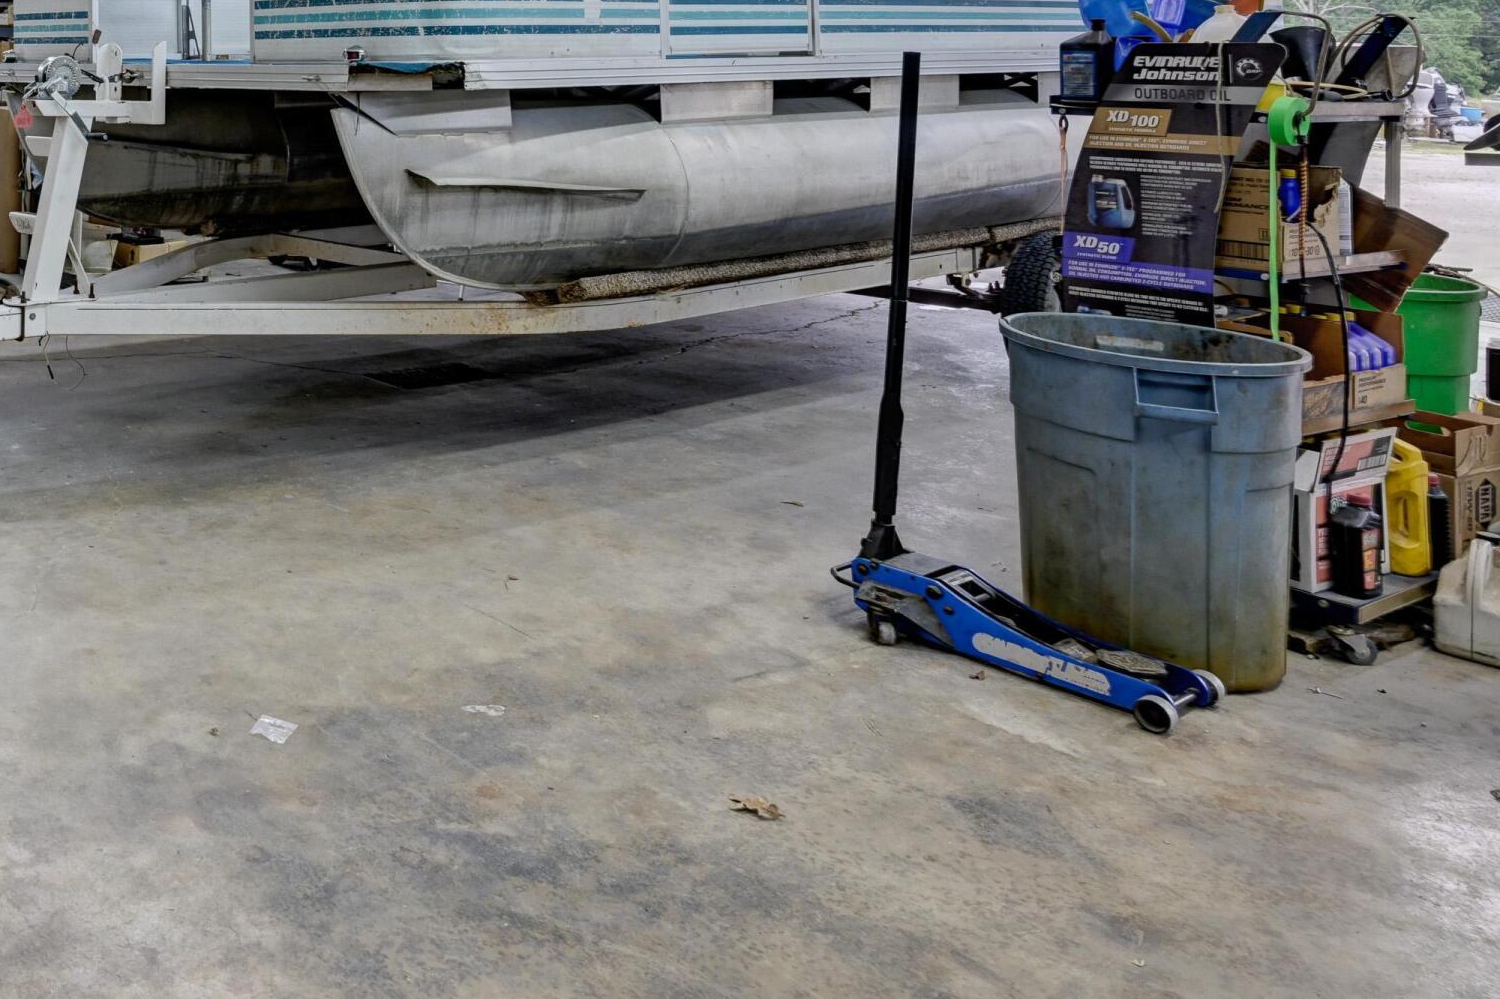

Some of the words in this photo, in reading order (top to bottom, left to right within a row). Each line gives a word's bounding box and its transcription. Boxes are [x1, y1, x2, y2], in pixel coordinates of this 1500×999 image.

[1132, 55, 1220, 68] EVINRUDE
[1132, 68, 1220, 81] Johnson
[1134, 87, 1205, 101] OUTBOARD
